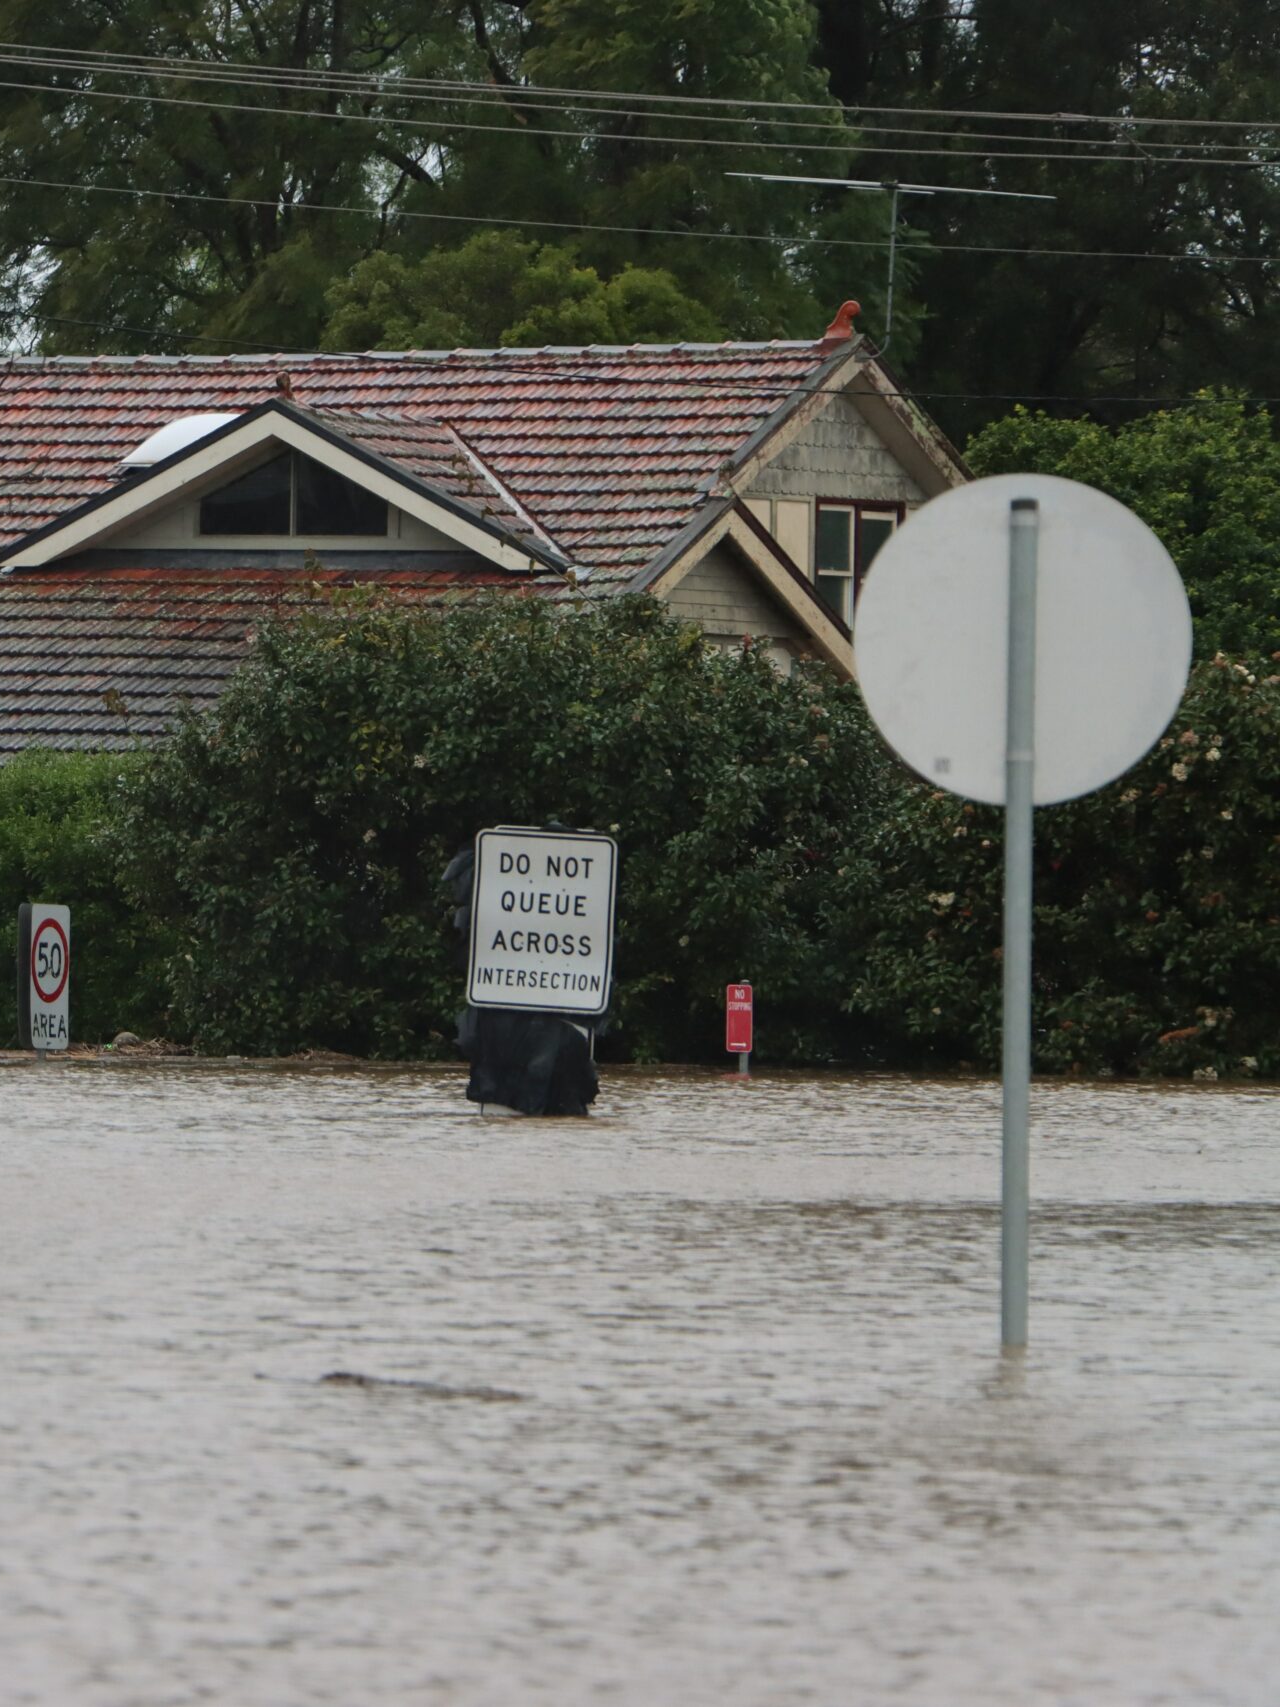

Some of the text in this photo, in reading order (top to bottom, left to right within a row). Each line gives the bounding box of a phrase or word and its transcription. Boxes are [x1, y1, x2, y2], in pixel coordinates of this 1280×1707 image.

[500, 852, 594, 879] DO NOT
[501, 890, 587, 917] QUEUE
[491, 930, 592, 957] ACROSS
[37, 942, 62, 979] 50
[477, 967, 601, 992] INTERSECTION
[734, 989, 745, 1000] NO
[32, 1013, 67, 1039] AREA
